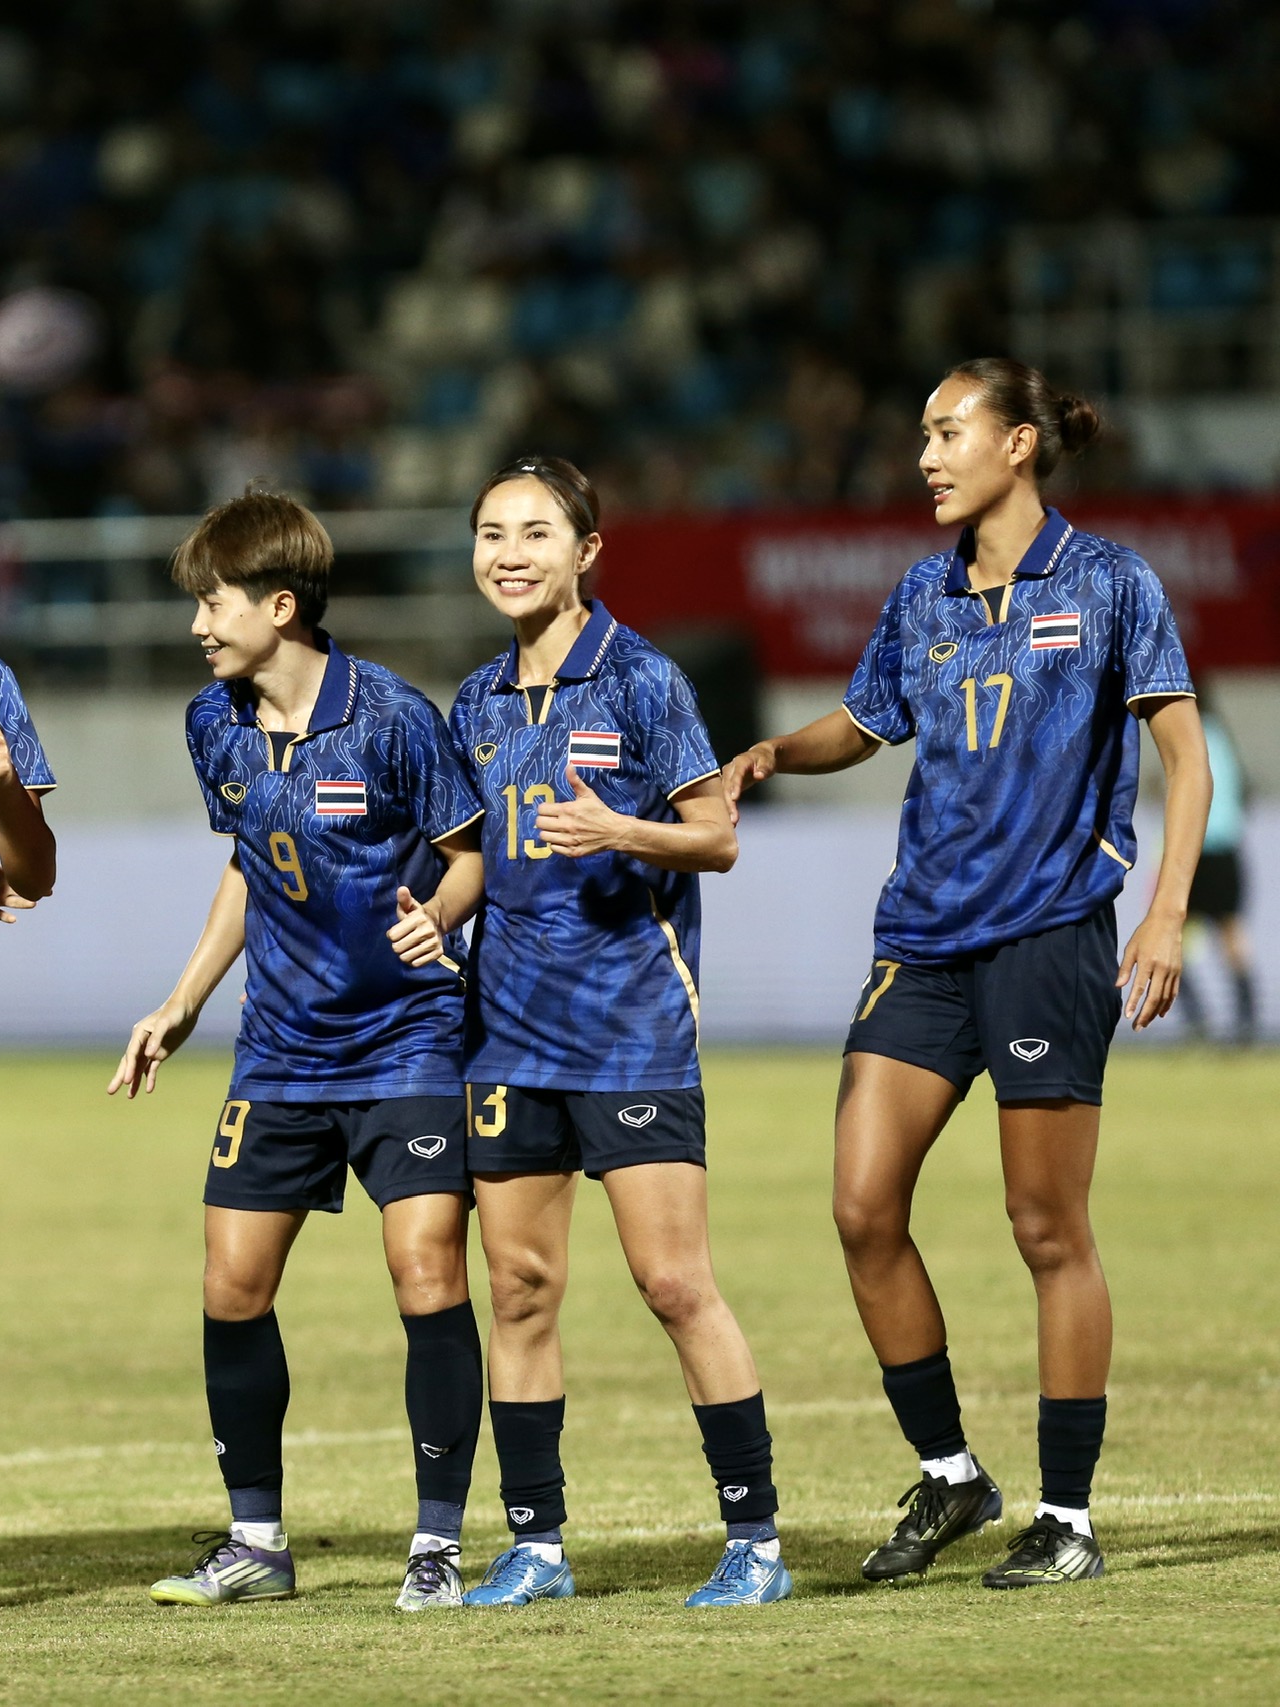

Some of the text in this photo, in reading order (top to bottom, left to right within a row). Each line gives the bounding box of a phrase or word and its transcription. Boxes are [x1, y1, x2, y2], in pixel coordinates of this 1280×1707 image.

[959, 673, 1015, 752] 17
[501, 784, 555, 859] 13
[269, 832, 309, 902] 9
[212, 1100, 252, 1169] 9
